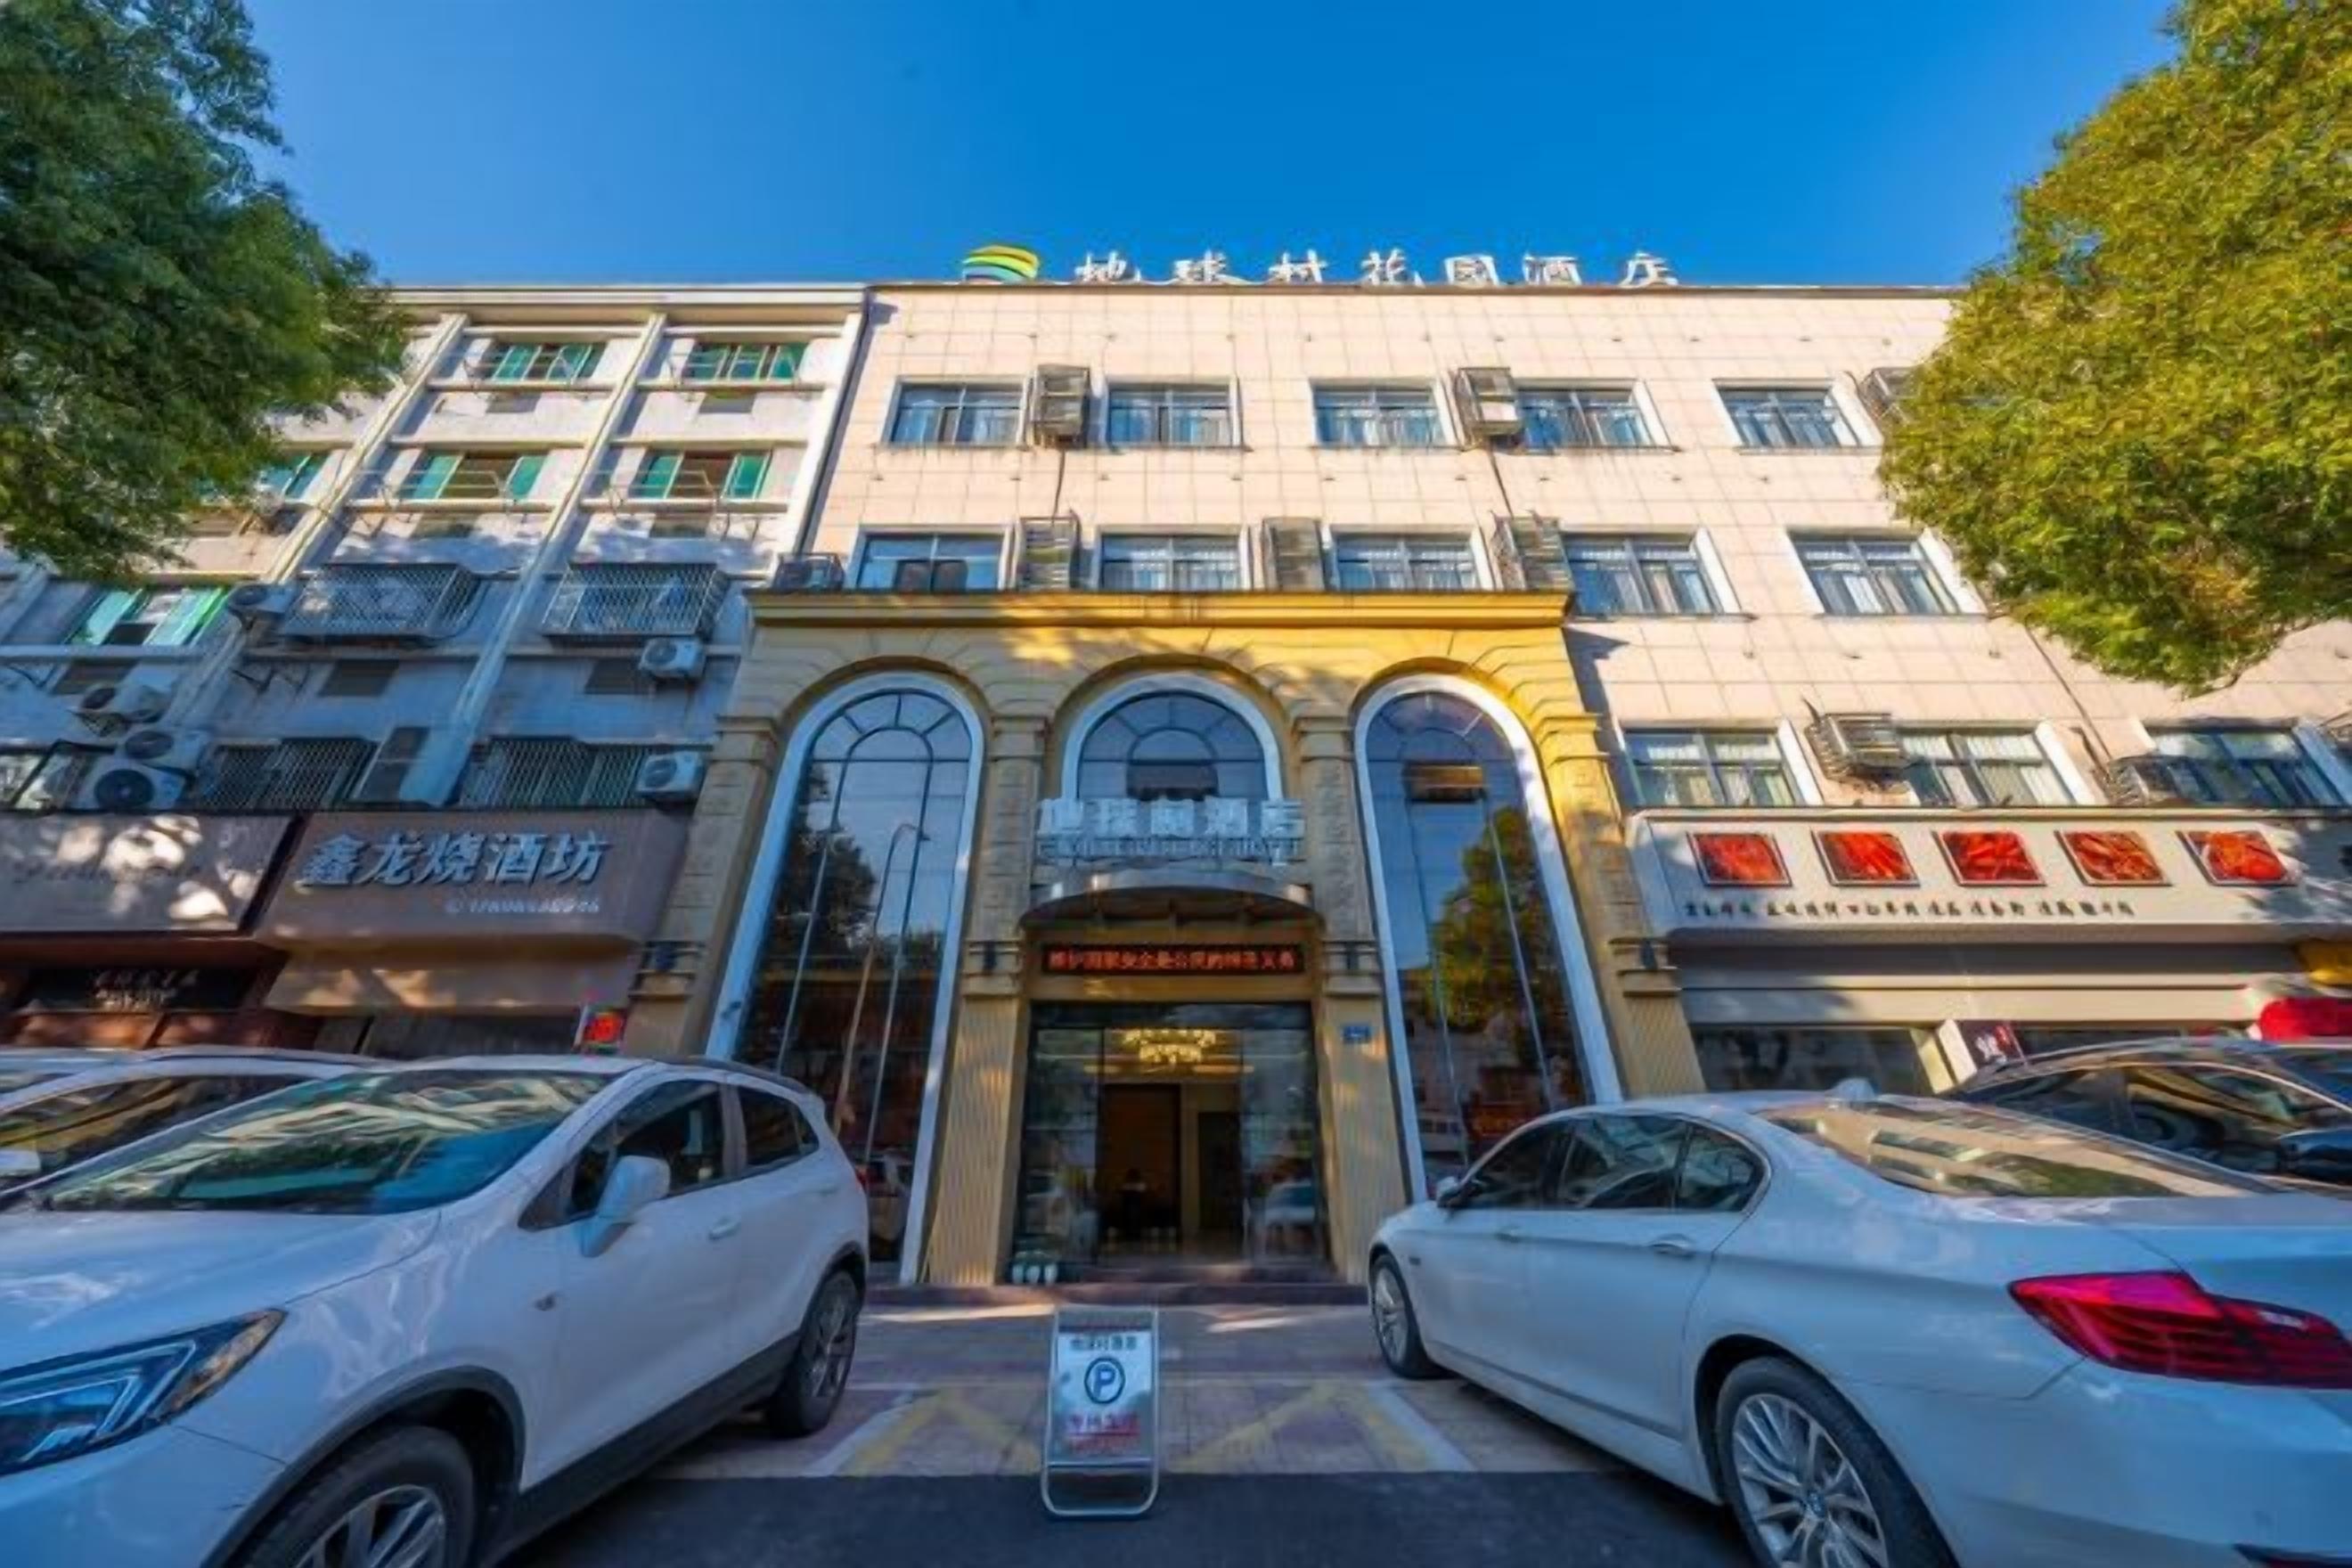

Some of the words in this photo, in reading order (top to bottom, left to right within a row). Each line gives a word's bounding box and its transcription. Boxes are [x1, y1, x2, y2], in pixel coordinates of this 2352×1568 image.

[302, 831, 609, 886] 鑫龙烧酒坊
[1093, 1364, 1116, 1398] P
